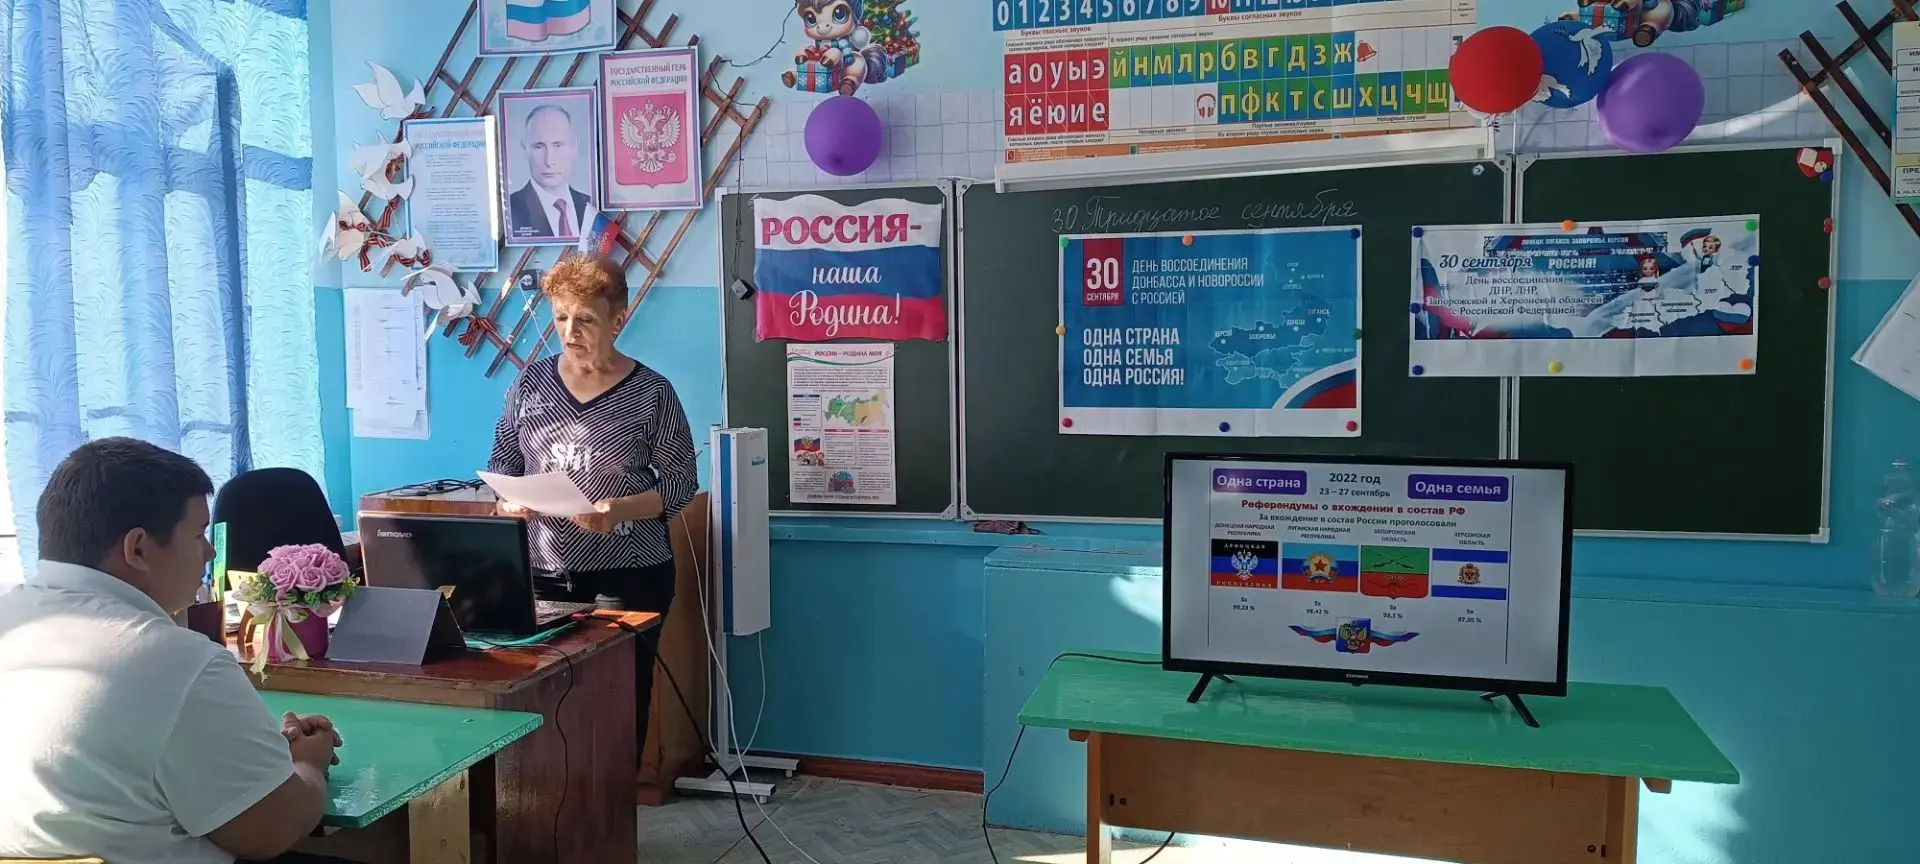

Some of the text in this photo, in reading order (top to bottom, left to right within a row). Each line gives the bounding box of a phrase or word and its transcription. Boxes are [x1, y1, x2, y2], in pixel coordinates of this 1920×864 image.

[997, 2, 1009, 25] 0
[1020, 1, 1028, 23] 1
[1038, 0, 1050, 22] 2
[1059, 0, 1071, 21] 3
[1021, 27, 1091, 37] Буквы гласных звуков
[610, 63, 688, 75] ГОСУДАРСТВЕННЫЙ ГЕРБ
[1009, 64, 1022, 84] а
[1050, 61, 1064, 89] у
[1069, 60, 1086, 81] ы
[1092, 59, 1105, 79] э
[1113, 48, 1127, 78] й
[1135, 56, 1148, 76] н
[1153, 55, 1172, 75] м
[1178, 53, 1192, 74] л
[1199, 51, 1214, 80] р
[1221, 42, 1236, 71] б
[1244, 49, 1258, 70] в
[1268, 47, 1279, 68] г
[1287, 46, 1306, 72] д
[1334, 42, 1353, 63] ж
[610, 75, 687, 86] РОССИЙСКОЙ ФЕДЕРАЦИИ
[1009, 106, 1023, 126] я
[1029, 98, 1042, 125] ё
[1048, 104, 1066, 124] ю
[1071, 102, 1085, 123] и
[1092, 101, 1106, 122] е
[1221, 94, 1236, 114] п
[1241, 86, 1260, 120] ф
[1290, 91, 1304, 111] т
[1333, 88, 1353, 109] ш
[1381, 85, 1397, 110] ц
[1406, 84, 1421, 104] ч
[1428, 82, 1448, 108] щ
[1052, 205, 1077, 233] 30
[761, 213, 922, 246] РОССИЯ-
[1132, 257, 1248, 274] ДЕНЬ ВОССОЕДИНЕНИЯ
[1440, 255, 1533, 273] 30 сентября
[1549, 258, 1597, 269] РОССИЯ!
[812, 266, 882, 285] наша
[1086, 257, 1119, 290] 30
[1465, 276, 1564, 285] День воссоединения
[1132, 273, 1264, 290] ДОНБАССА И НОВОРОССИИ
[1087, 293, 1119, 302] СЕНТЯБРЯ
[1132, 290, 1186, 305] С РОССИЕЙ
[1489, 286, 1538, 296] ДНР, ЛНР,
[1427, 296, 1488, 307] Запорожской
[1500, 296, 1556, 307] Херсонской
[1558, 295, 1605, 304] областей
[789, 289, 901, 337] Родина!
[1460, 307, 1514, 316] Российской
[1517, 306, 1576, 316] Федерацией
[1083, 328, 1180, 347] ОДНА СТРАНА
[1083, 348, 1173, 367] ОДНА СЕМЬЯ
[1083, 368, 1185, 387] ОДНА РОССИЯ!
[1217, 475, 1301, 490] Одна страна
[1329, 473, 1381, 486] 2022 год
[1338, 488, 1349, 496] 27
[1351, 489, 1390, 498] сентябрь
[1415, 481, 1501, 495] Одна семья
[1241, 500, 1318, 512] Референдумы
[1332, 504, 1394, 514] вхождении
[1407, 507, 1445, 515] состав
[1449, 506, 1466, 515] РФ
[1259, 513, 1269, 521] За
[1270, 515, 1318, 524] вхождение
[1357, 516, 1387, 525] России
[1390, 518, 1456, 528] проголосовали
[377, 529, 412, 538] lenovo
